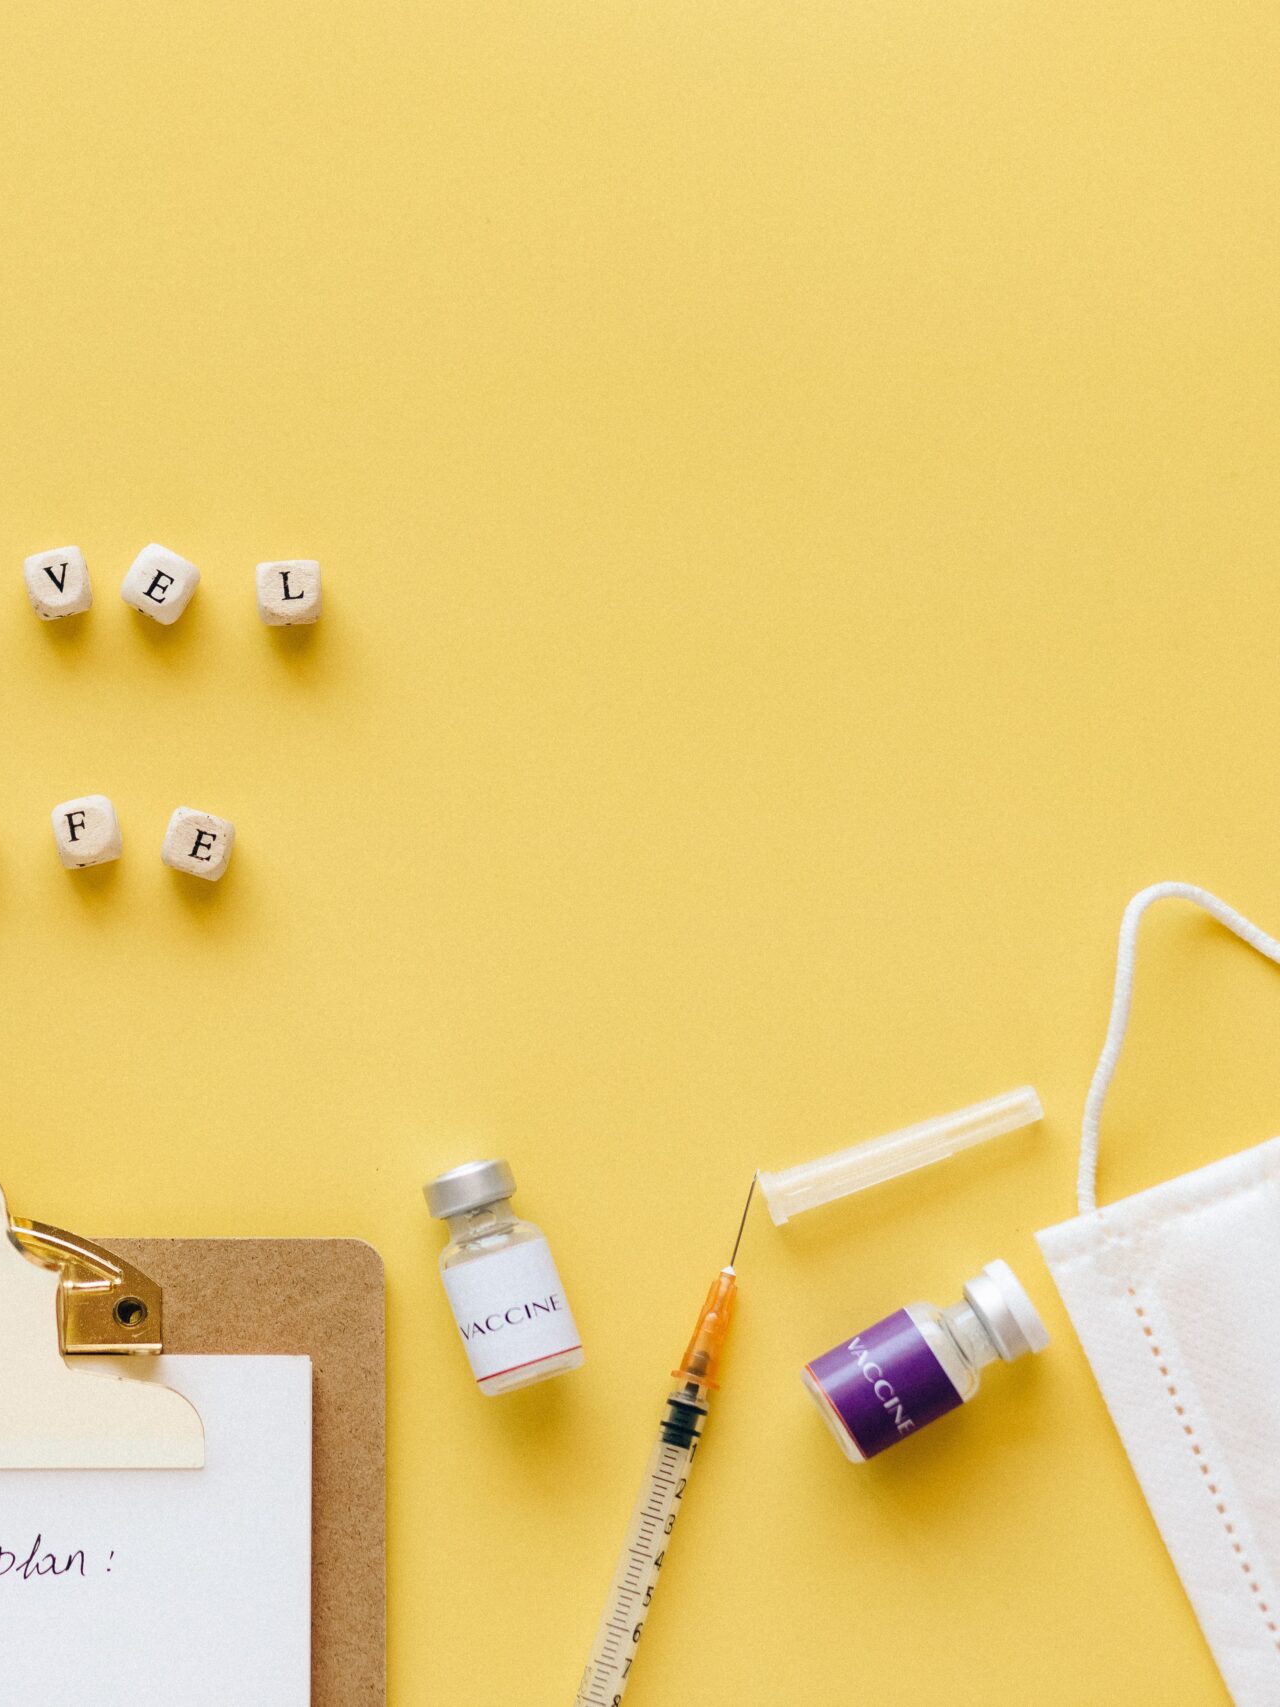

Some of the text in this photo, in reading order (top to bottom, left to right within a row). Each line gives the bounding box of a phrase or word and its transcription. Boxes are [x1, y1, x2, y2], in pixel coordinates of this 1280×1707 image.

[459, 1293, 563, 1340] VACCINE
[847, 1336, 916, 1434] VACCINE
[690, 1443, 698, 1463] 1
[675, 1478, 687, 1499] 2
[664, 1514, 676, 1535] 3
[654, 1551, 665, 1571] 4
[642, 1586, 654, 1607] 5
[632, 1622, 644, 1643] 6
[621, 1657, 633, 1679] 7
